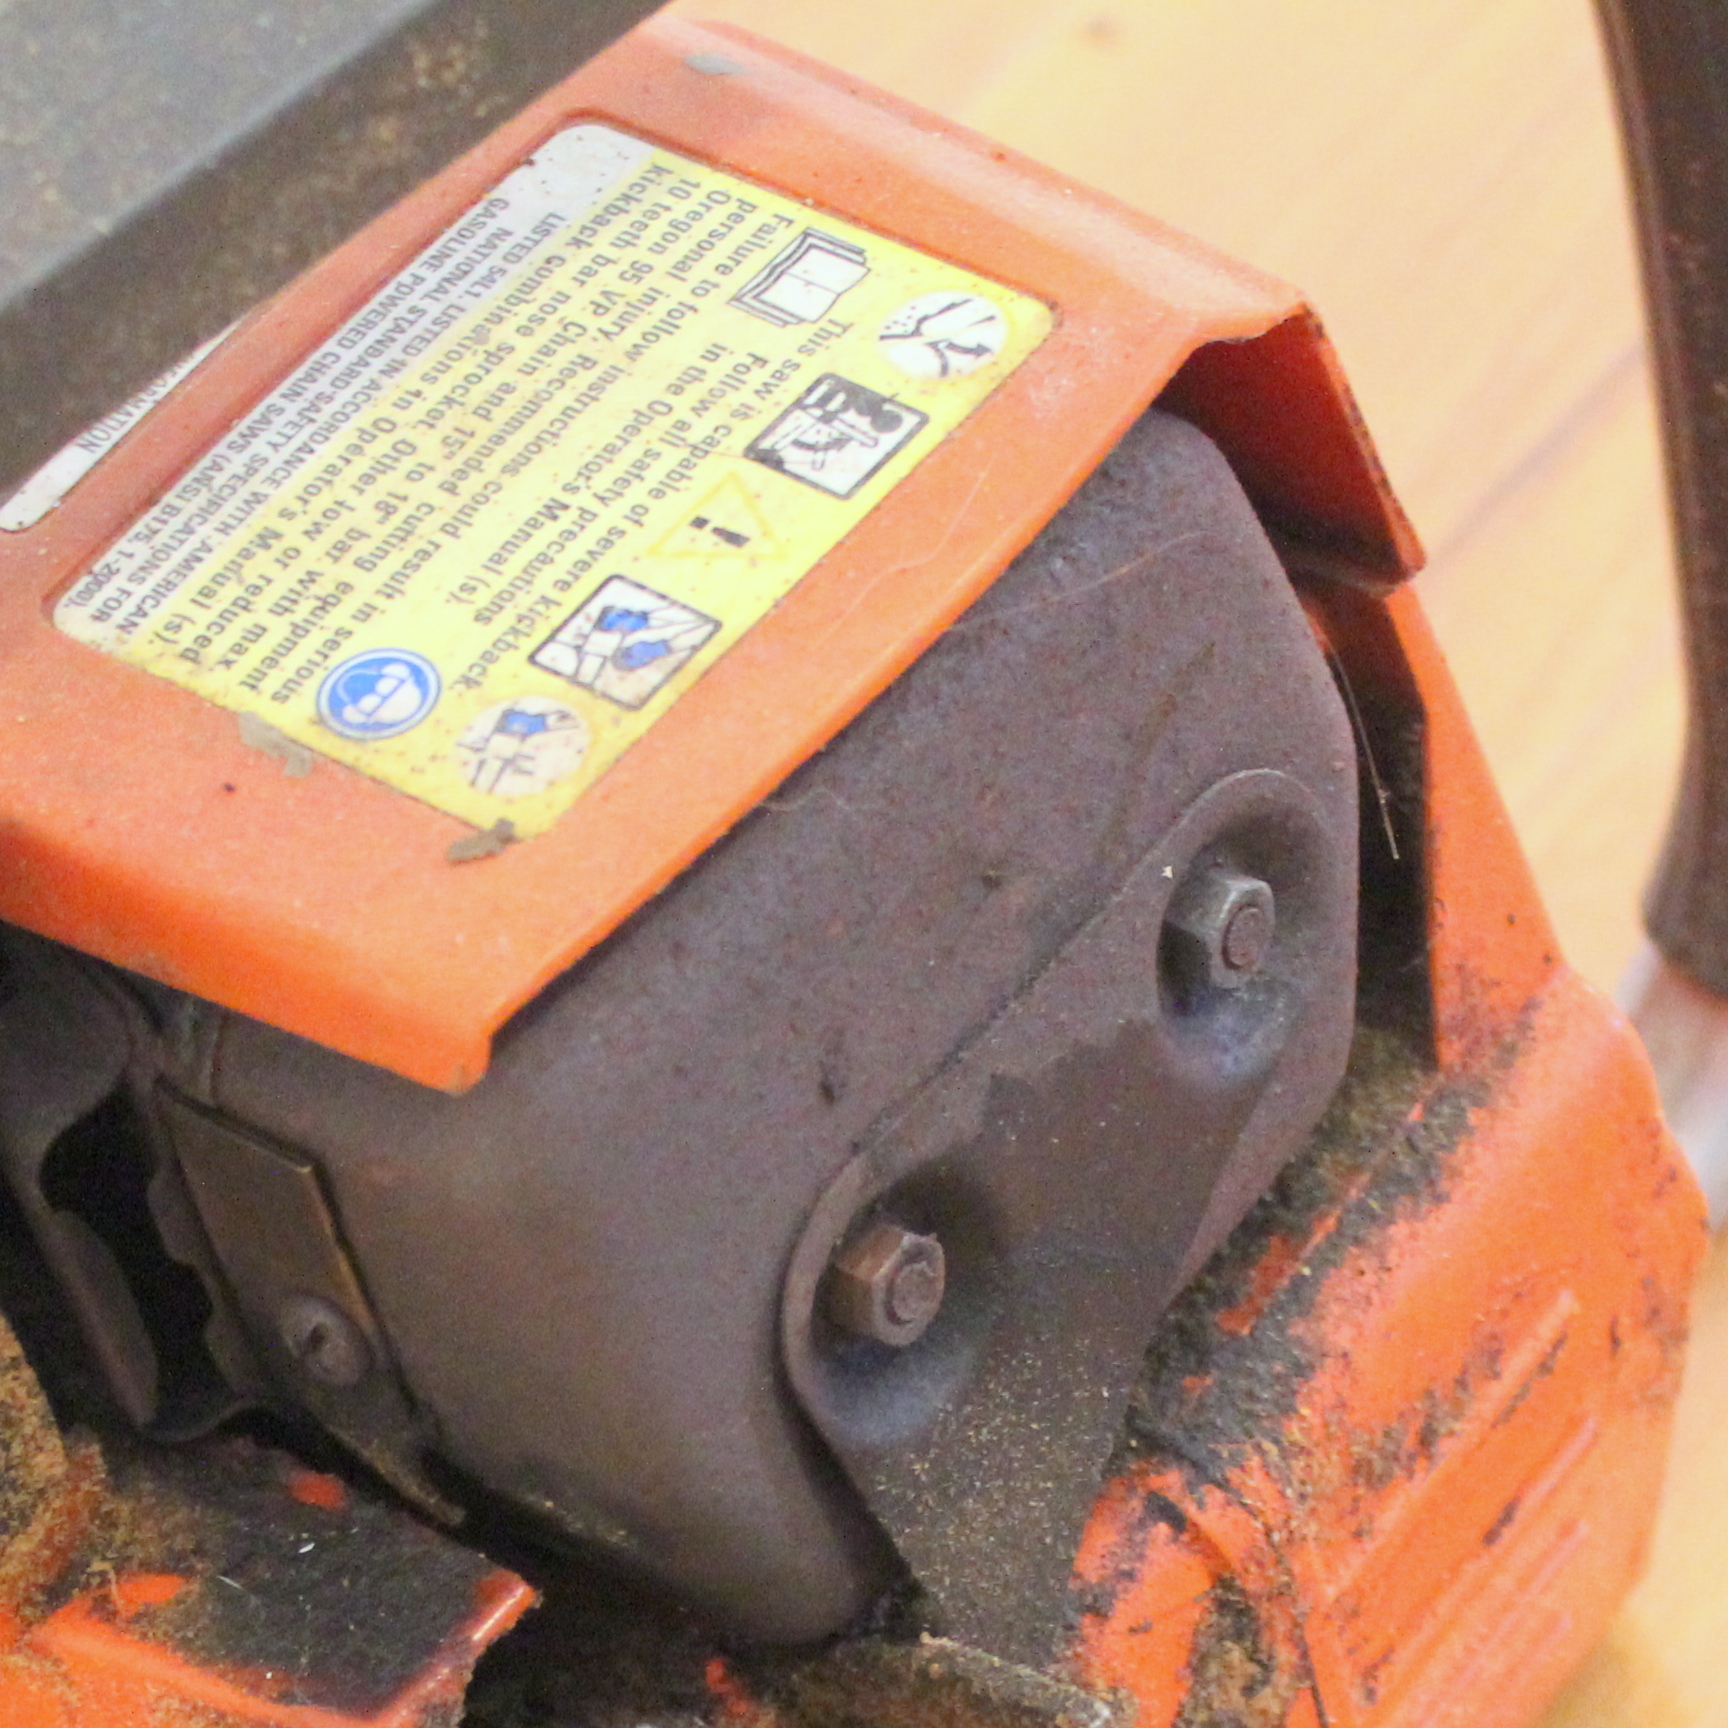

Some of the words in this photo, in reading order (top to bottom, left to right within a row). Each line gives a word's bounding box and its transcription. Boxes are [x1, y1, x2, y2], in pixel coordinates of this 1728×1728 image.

[562, 161, 675, 254] kickback
[662, 175, 703, 202] 10
[416, 194, 514, 275] GASOLINE
[497, 210, 569, 267] LISTED
[606, 199, 675, 253] teeth
[640, 184, 736, 259] Oregon
[658, 196, 764, 283] personal
[710, 211, 796, 280] Failure
[417, 225, 515, 307] NATIONAL
[565, 252, 619, 291] bar
[614, 257, 657, 286] 95
[686, 276, 723, 301] to
[331, 270, 429, 352] POWERED
[397, 301, 468, 359] LISTED
[416, 252, 574, 389] combinations
[511, 288, 573, 339] nose
[618, 298, 702, 366] follow
[793, 315, 853, 360] This
[275, 348, 345, 404] CHAIN
[325, 303, 430, 393] STANDARD
[375, 355, 411, 380] IN
[513, 318, 591, 380] Chain
[697, 341, 735, 366] in
[748, 356, 806, 402] saw
[388, 385, 431, 415] in
[404, 338, 523, 437] sprocket.
[467, 379, 525, 423] and
[662, 363, 712, 400] the
[684, 350, 771, 421] Follow
[726, 401, 763, 424] is
[222, 401, 290, 456] SAWS
[258, 377, 388, 491] ACCORDANCE
[260, 390, 339, 455] SAFETY
[434, 351, 601, 498] Recommended
[497, 363, 634, 482] instructions
[553, 394, 677, 499] Operator's
[655, 417, 701, 450] all
[169, 451, 238, 505] (ANSI
[343, 437, 421, 499] Other
[401, 460, 439, 486] to
[587, 444, 671, 510] safety
[636, 419, 741, 504] capable
[121, 452, 275, 588] SPECIFICATIONS
[210, 488, 271, 538] WITH
[296, 496, 359, 545] low
[348, 498, 444, 576] cutting
[435, 478, 512, 540] could
[478, 496, 574, 576] Manual
[618, 501, 658, 528] of
[109, 538, 222, 636] AMERICAN
[185, 525, 287, 610] Manual
[269, 544, 304, 570] or
[372, 538, 451, 603] result
[463, 505, 605, 628] precautions
[549, 523, 632, 595] severe
[84, 585, 137, 626] FOR
[173, 573, 284, 667] reduced
[264, 567, 331, 620] with
[347, 600, 386, 627] in
[440, 571, 494, 611] (s).
[225, 575, 365, 694] equipment
[444, 594, 564, 698] kickback.
[265, 624, 363, 708] serious
